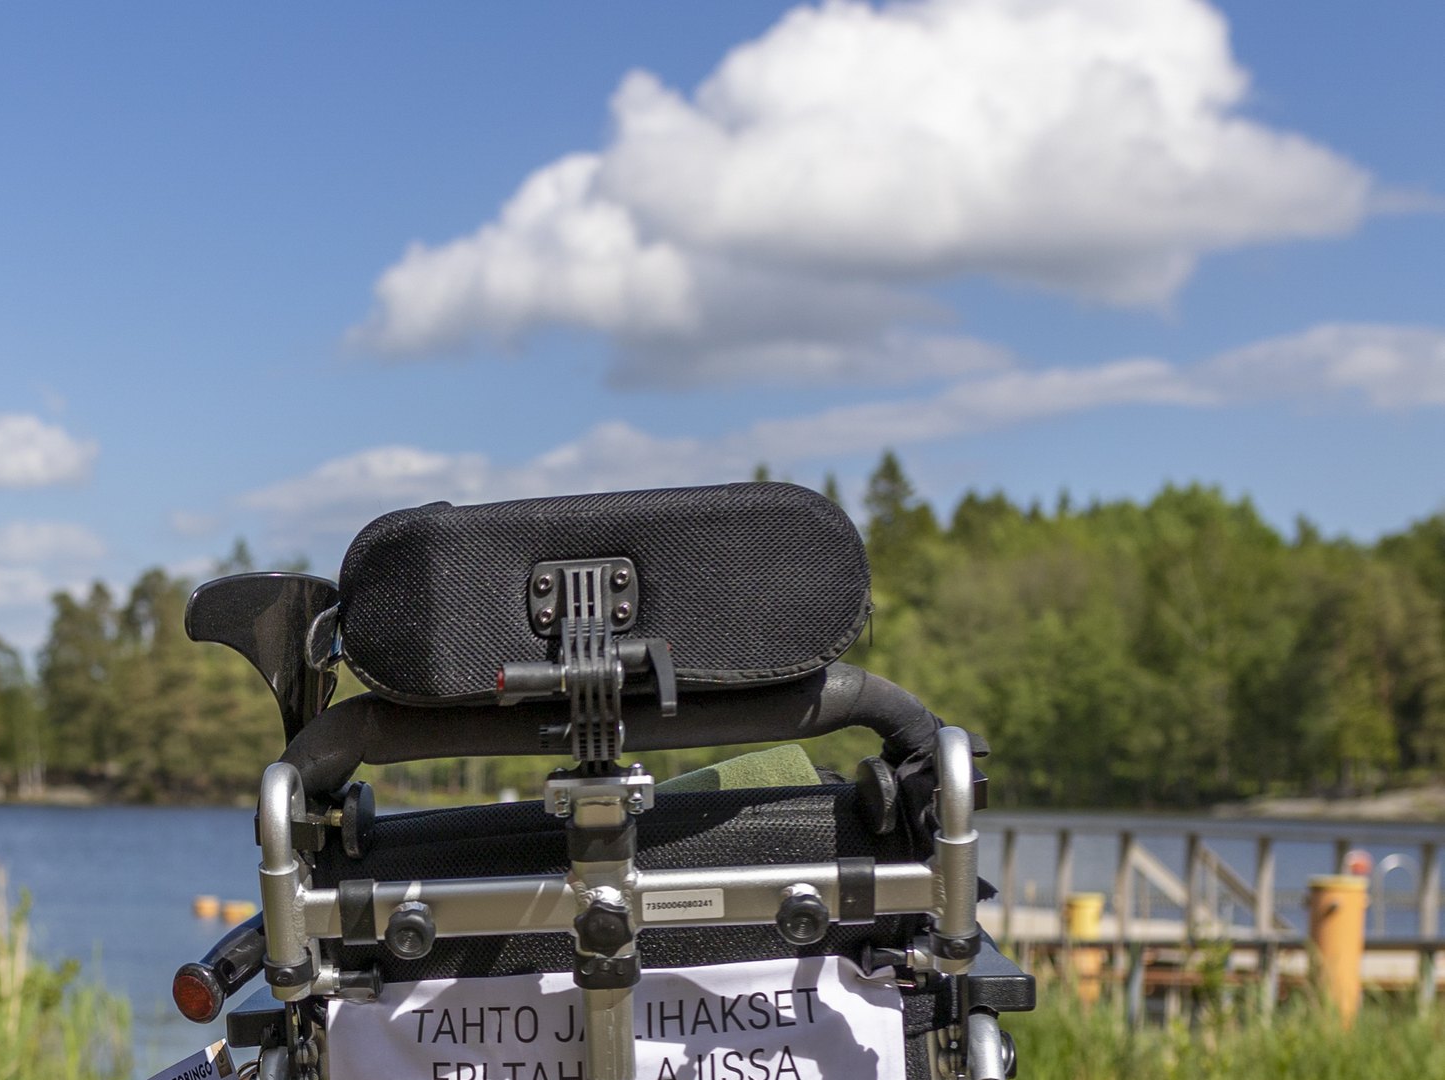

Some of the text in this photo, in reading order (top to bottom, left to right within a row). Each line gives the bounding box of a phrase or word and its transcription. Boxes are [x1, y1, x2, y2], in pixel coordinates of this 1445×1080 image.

[411, 986, 818, 1044] TAHTO J IHAKSET
